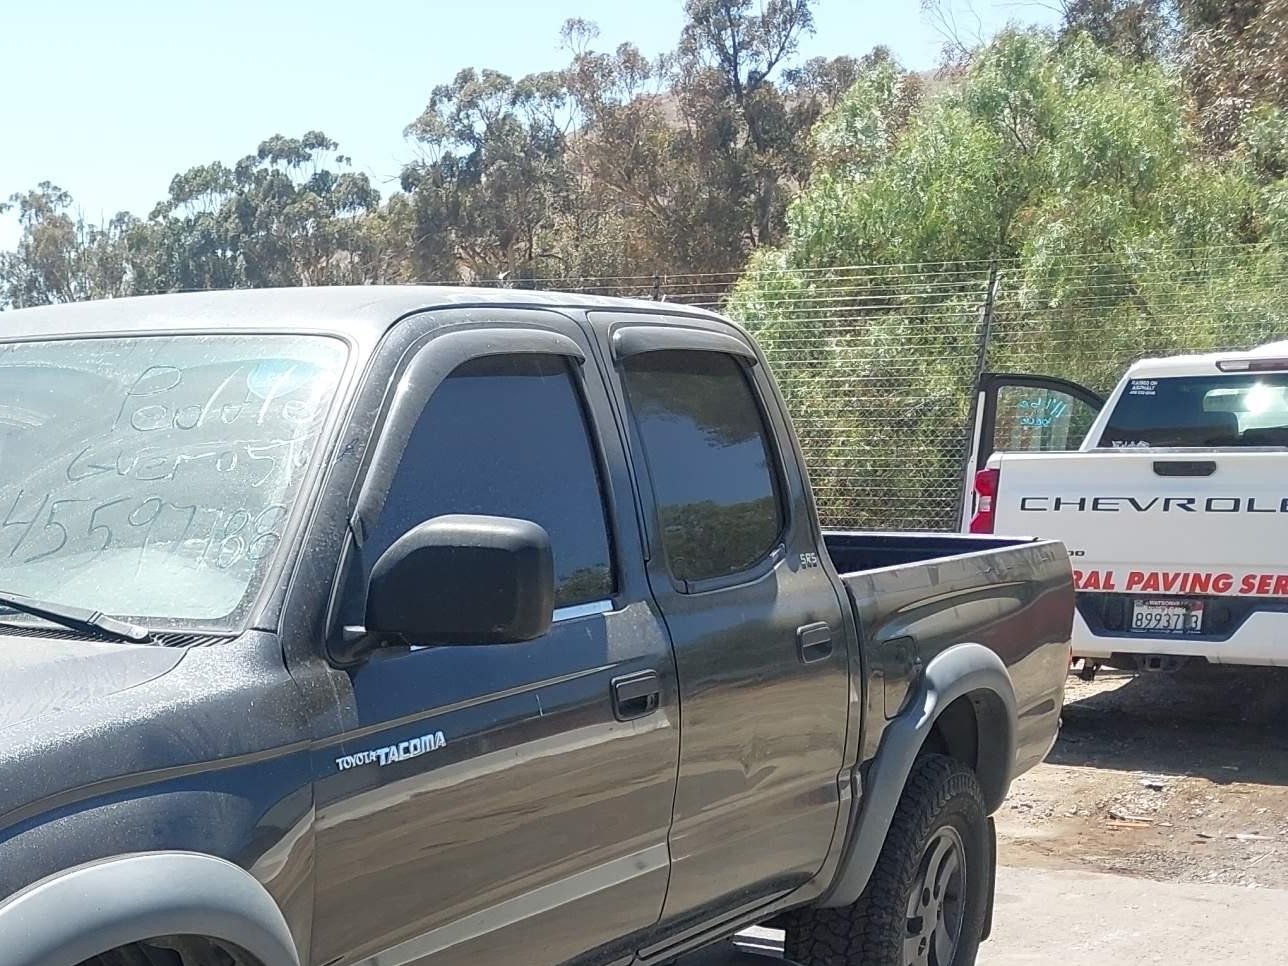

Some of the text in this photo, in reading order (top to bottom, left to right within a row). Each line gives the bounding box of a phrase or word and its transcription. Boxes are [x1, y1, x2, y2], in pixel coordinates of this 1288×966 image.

[2, 489, 288, 577] 45597788
[1126, 571, 1234, 595] PAVING
[1134, 612, 1199, 631] 899373
[335, 730, 448, 771] TOYOTA TACOMA
